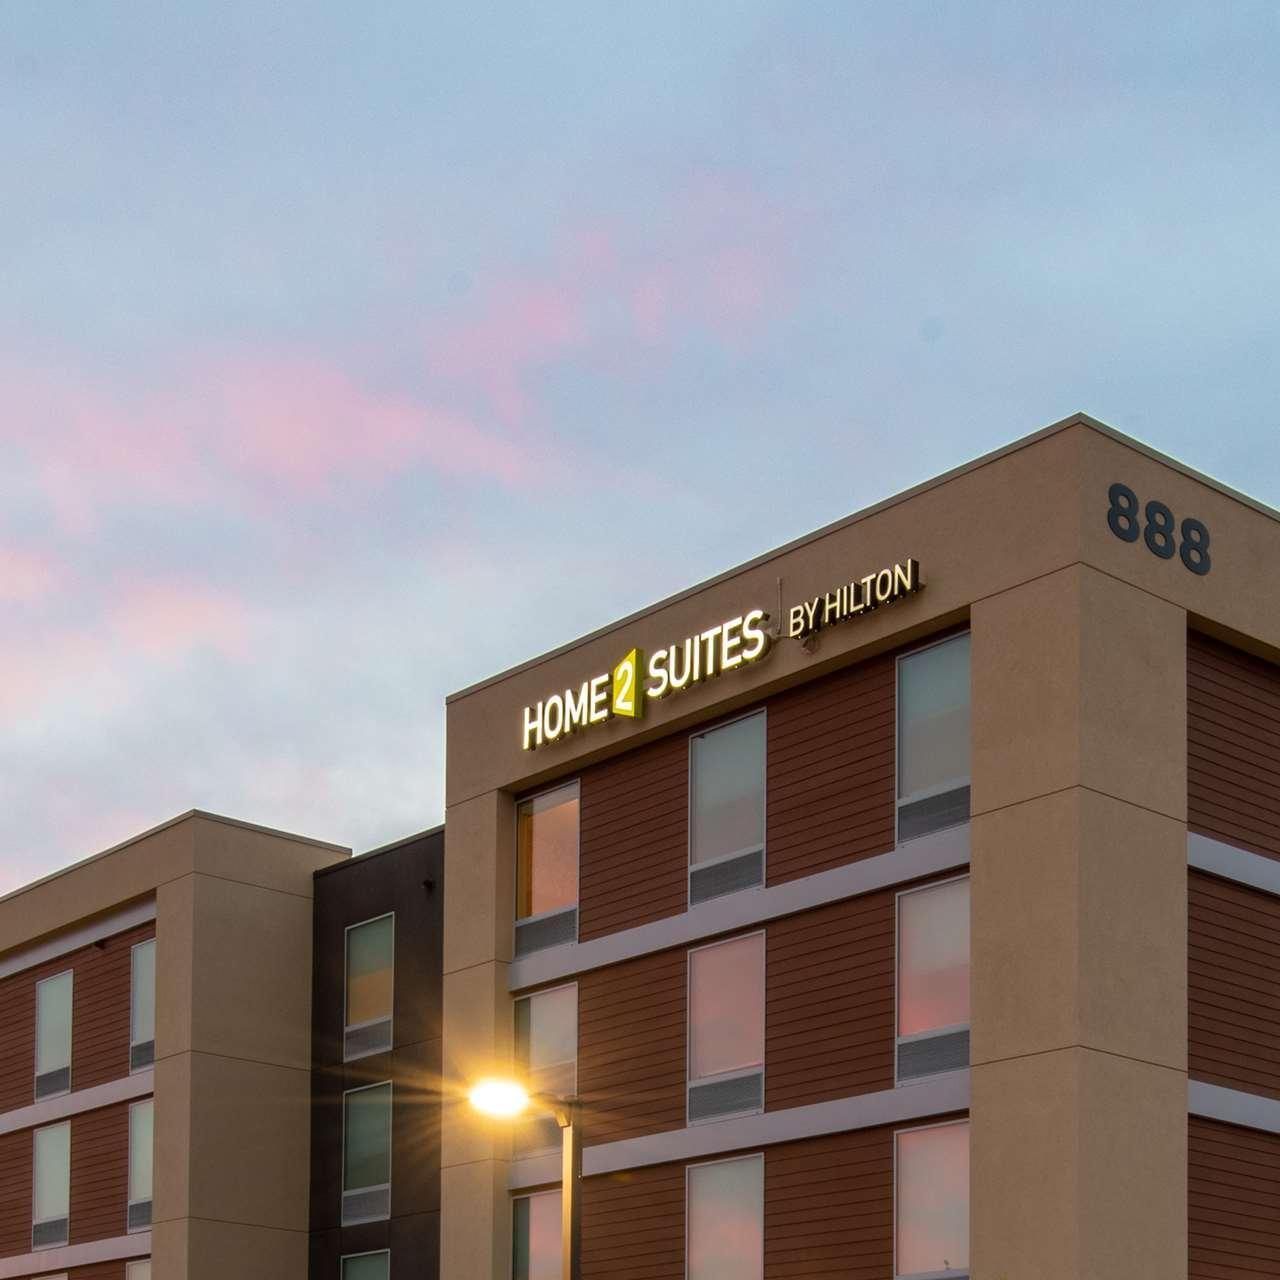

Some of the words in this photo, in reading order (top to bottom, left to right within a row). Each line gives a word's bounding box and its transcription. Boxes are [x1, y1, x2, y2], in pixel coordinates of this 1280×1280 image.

[1107, 482, 1212, 577] 888
[646, 608, 766, 698] SUITES
[789, 596, 820, 638] BY
[824, 557, 915, 624] HILTON
